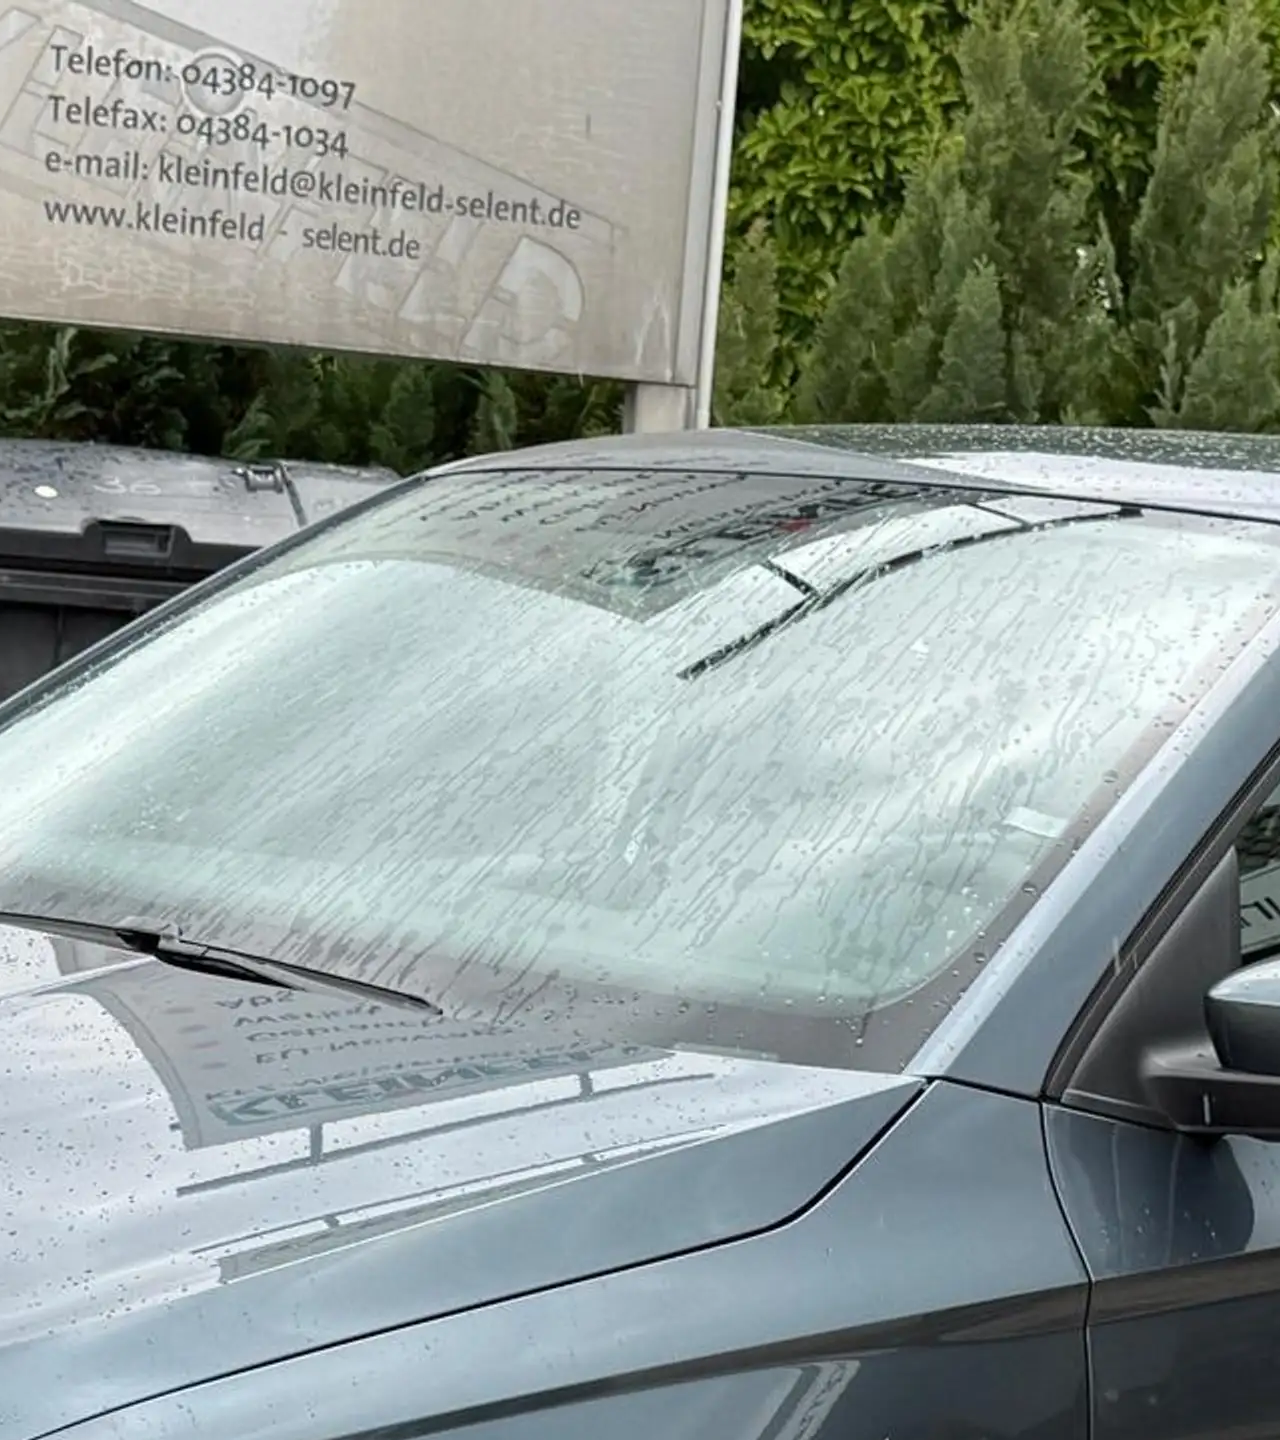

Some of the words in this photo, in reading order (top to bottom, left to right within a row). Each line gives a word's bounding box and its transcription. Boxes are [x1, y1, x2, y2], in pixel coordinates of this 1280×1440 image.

[50, 44, 172, 82] Telefon:
[181, 62, 356, 109] 04384-1097
[47, 94, 167, 132] Telefax:
[176, 113, 349, 160] 04384-1034
[44, 147, 149, 181] e-mail:
[157, 152, 582, 230] kleinfeld@kleinfeld-selent.de
[44, 198, 265, 243] www.kleinfeld
[302, 223, 421, 261] selent.de
